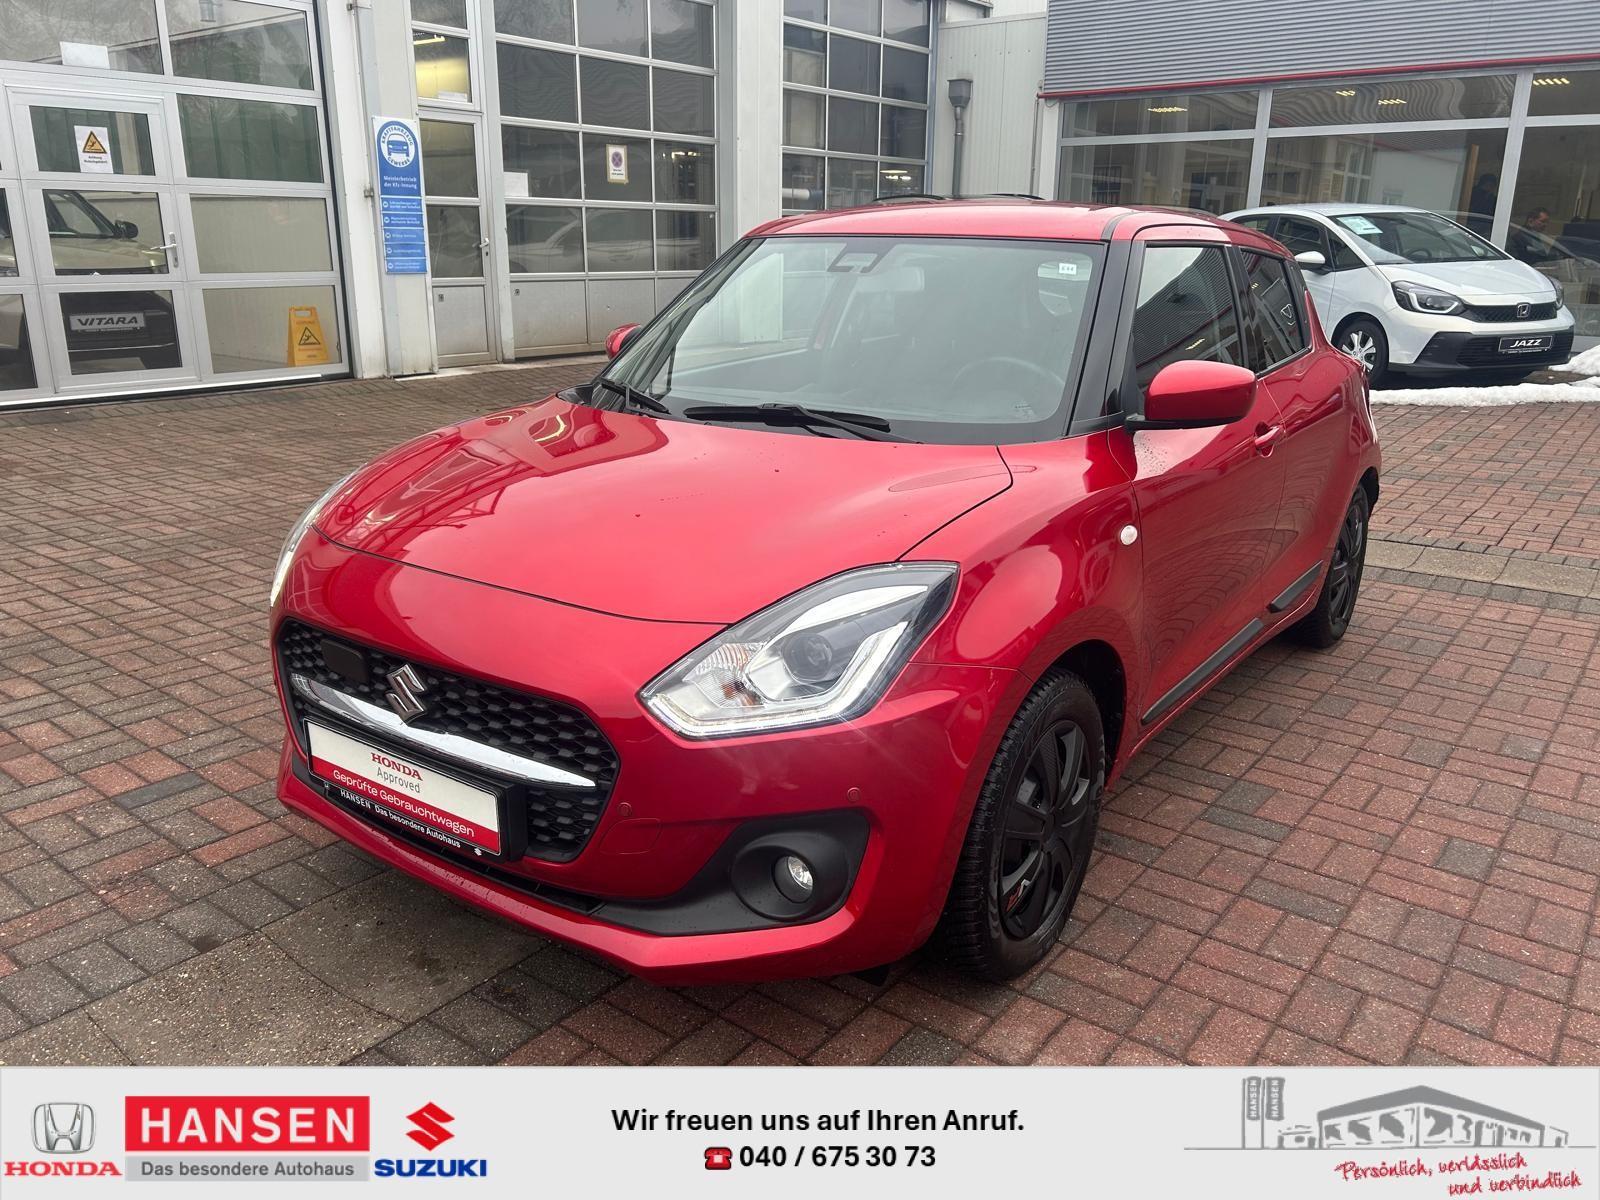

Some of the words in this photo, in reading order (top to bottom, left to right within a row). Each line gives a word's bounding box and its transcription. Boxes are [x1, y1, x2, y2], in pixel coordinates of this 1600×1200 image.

[77, 316, 138, 326] VITARA
[1510, 339, 1542, 347] JAZZ
[370, 752, 423, 781] HONDA
[376, 767, 421, 794] Approved
[333, 769, 378, 796] Geprüfte
[379, 789, 475, 838] Gebrauchtwagen
[340, 789, 371, 809] HANSEN
[375, 804, 389, 818] Das
[388, 808, 425, 833] besondere
[426, 826, 461, 848] Autohaus
